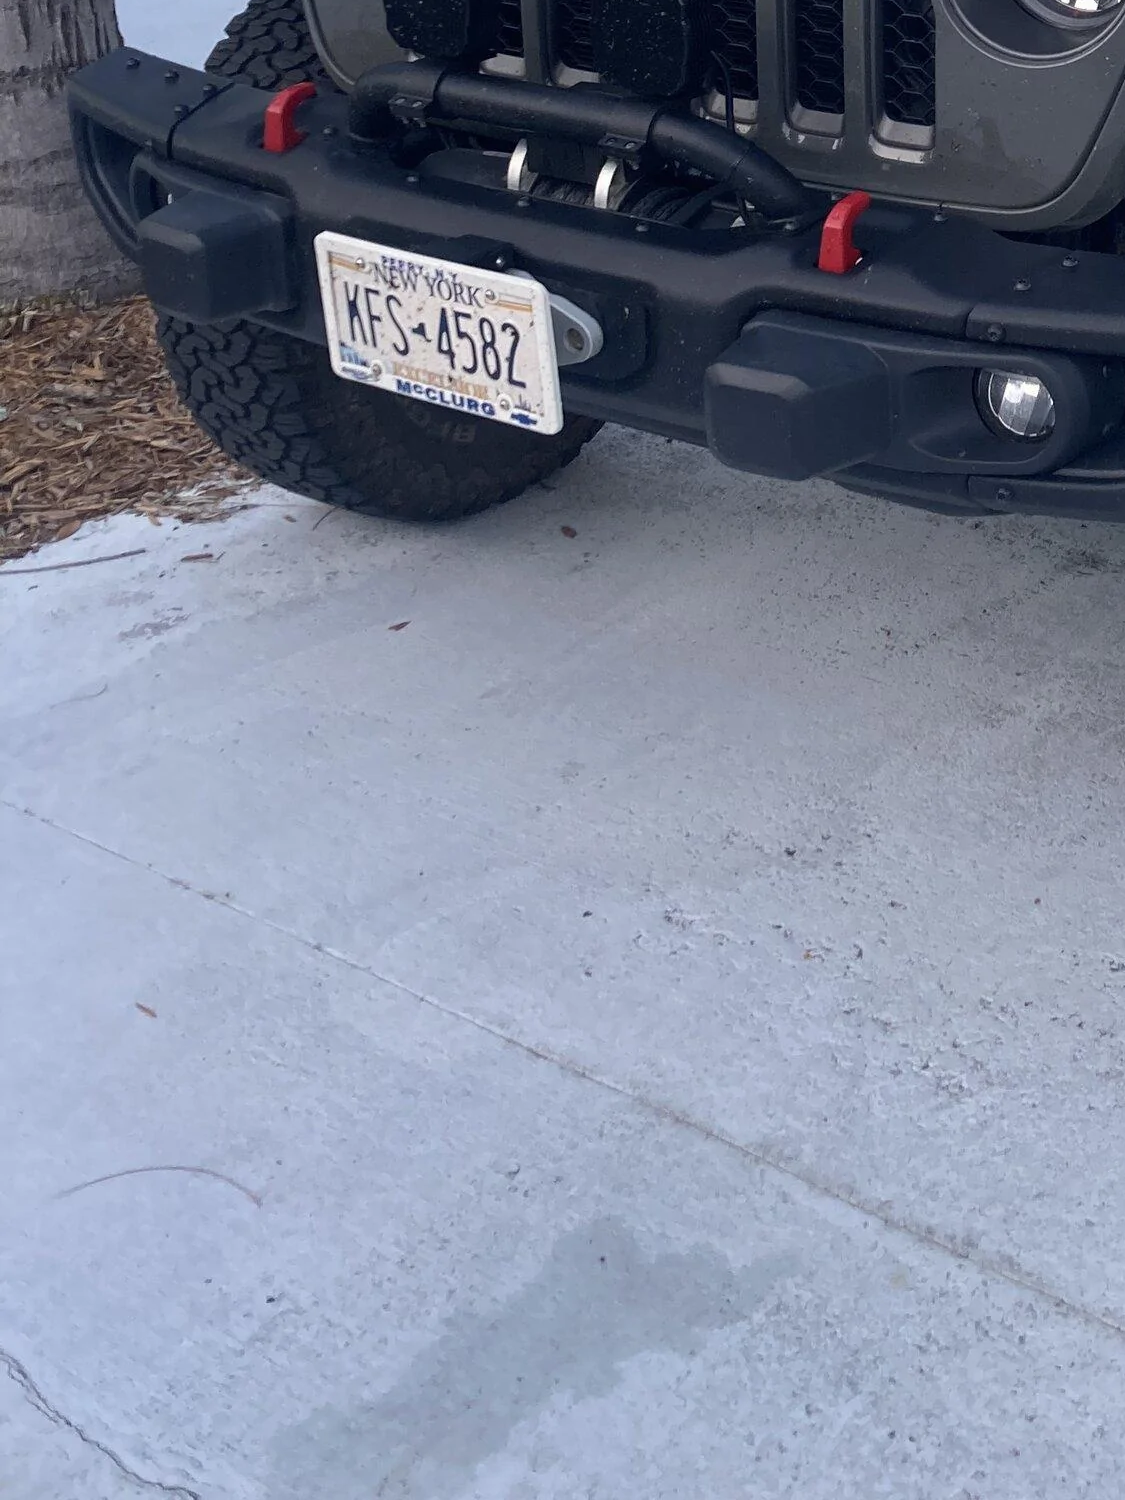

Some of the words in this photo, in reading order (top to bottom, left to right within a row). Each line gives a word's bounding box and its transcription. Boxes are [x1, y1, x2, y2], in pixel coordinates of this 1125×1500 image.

[370, 262, 418, 293] NEW
[424, 274, 483, 309] YORK
[344, 281, 410, 357] KFS
[437, 307, 526, 388] 4582
